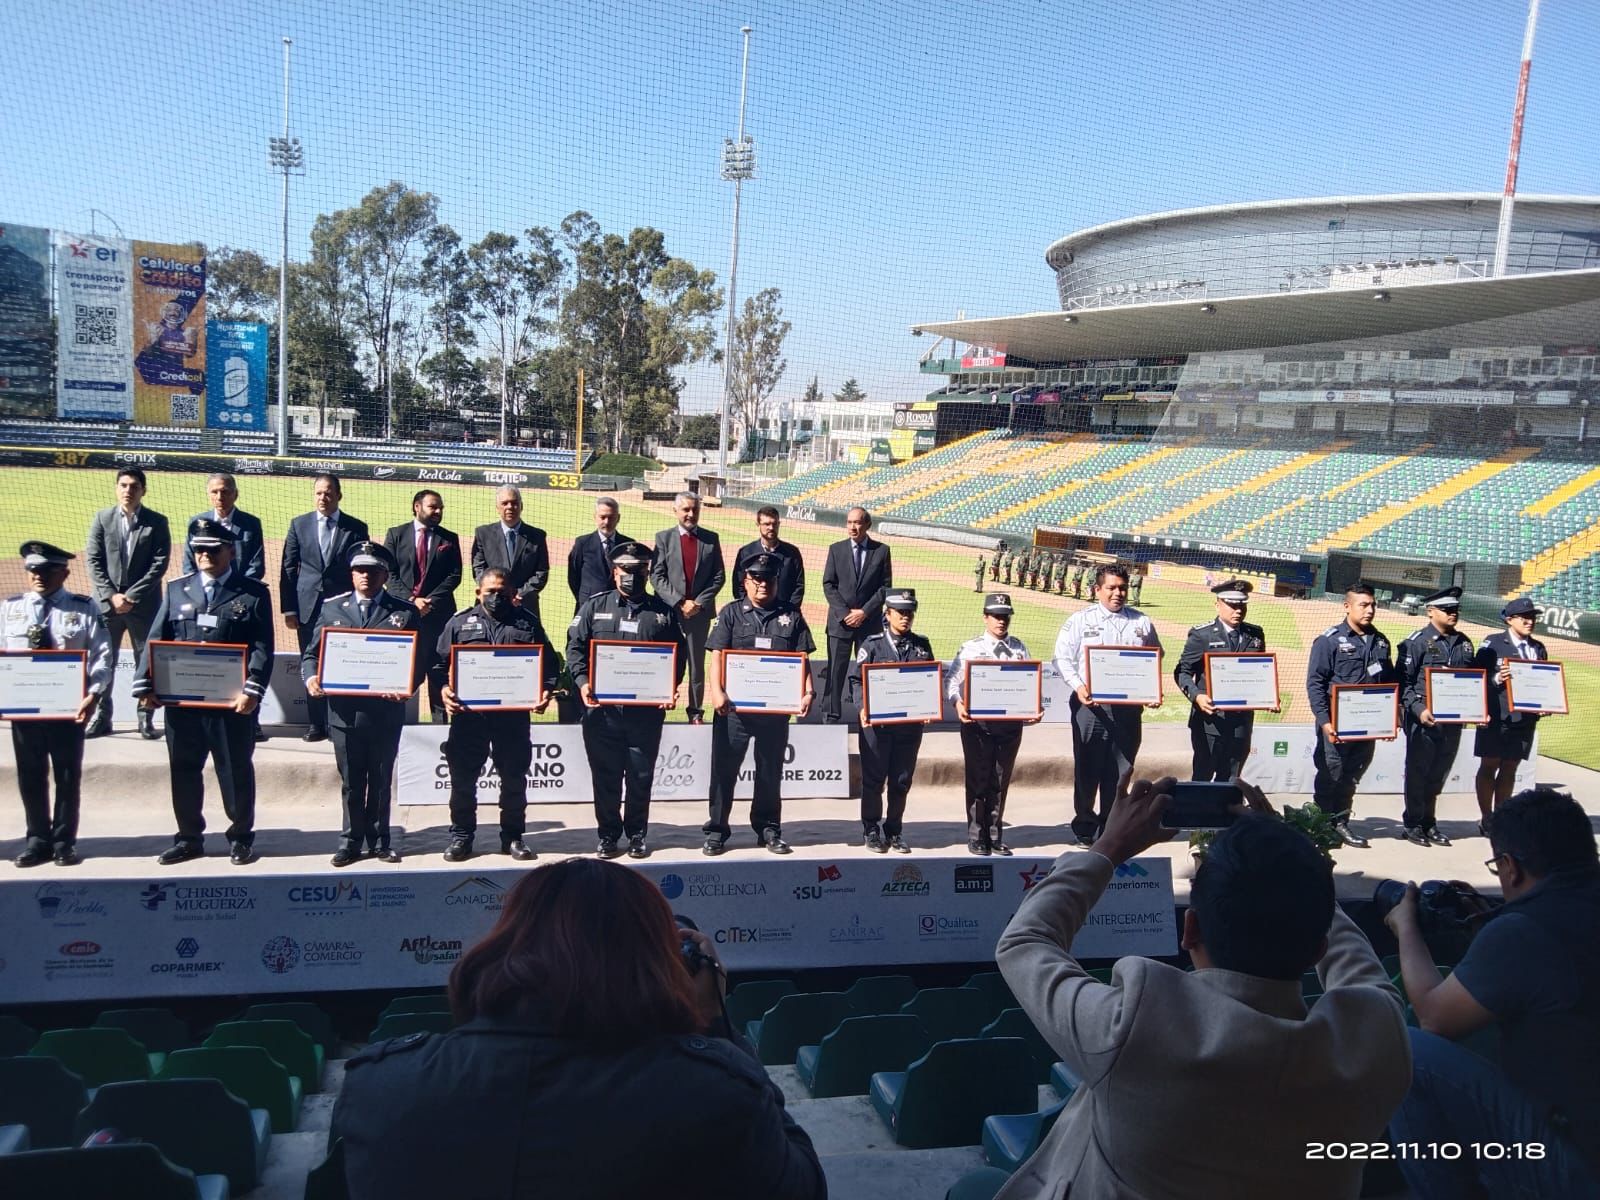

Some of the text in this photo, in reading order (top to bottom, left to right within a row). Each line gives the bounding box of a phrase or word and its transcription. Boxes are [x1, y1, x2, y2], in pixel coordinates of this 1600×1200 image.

[65, 270, 126, 283] transporte
[54, 451, 90, 466] 387
[483, 470, 521, 484] TECATE
[548, 473, 579, 488] 325
[1199, 543, 1301, 562] PERICOSDEPUEBLA.COM
[808, 769, 842, 781] 2022
[688, 873, 720, 883] GRUPO
[688, 883, 767, 897] EXCELENCIA
[881, 881, 931, 893] AZTECA
[956, 879, 992, 891] a.m.p
[1107, 880, 1161, 891] mperiomex
[175, 886, 249, 899] CHRISTUS
[287, 880, 362, 905] CESUMA
[175, 898, 256, 911] MUGUERZA
[1089, 912, 1163, 926] INTERCERAMIC
[303, 951, 363, 962] COMERCIO
[150, 962, 222, 973] COPARMEX
